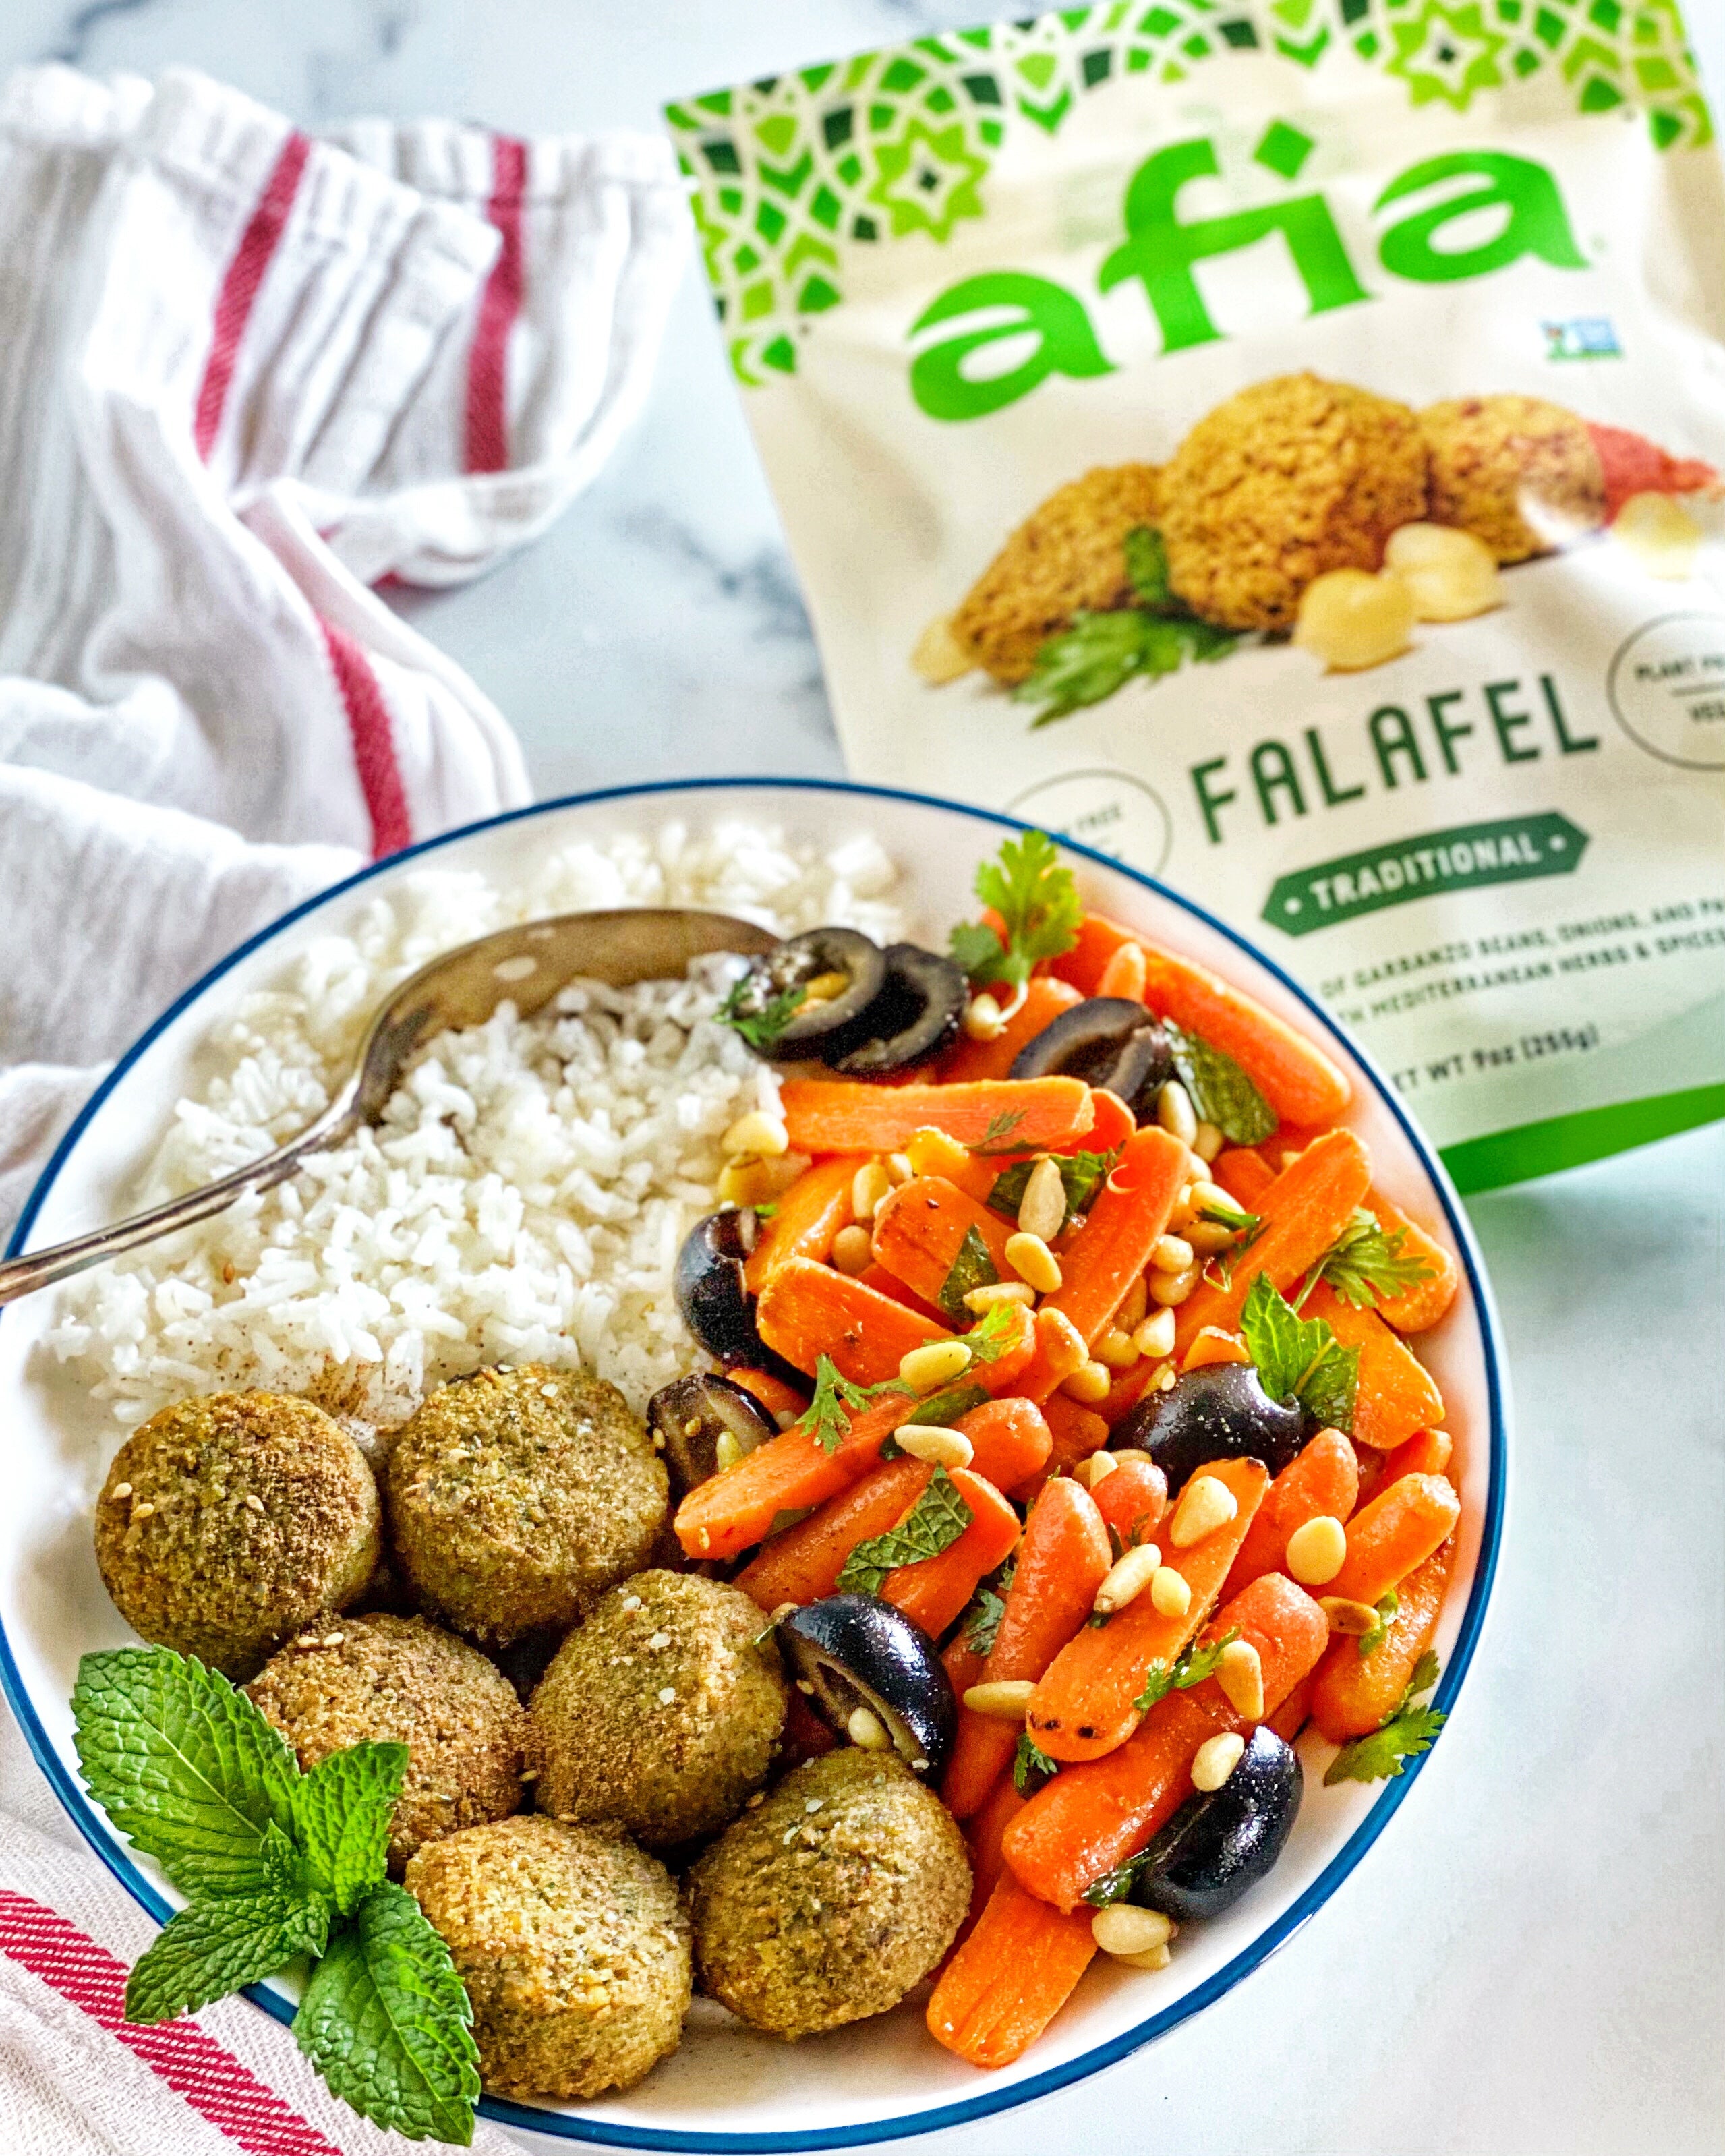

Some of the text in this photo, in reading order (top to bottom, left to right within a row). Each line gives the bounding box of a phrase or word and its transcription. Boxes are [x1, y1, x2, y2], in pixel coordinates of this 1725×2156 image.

[906, 119, 1593, 424] afia
[1190, 675, 1601, 844] FALAFEL
[1309, 832, 1542, 912] TRADITIONAL
[1353, 941, 1473, 988] GARBANZO
[1650, 900, 1695, 925] AND
[1370, 962, 1554, 1018] MEDITERRANEAN
[1556, 943, 1630, 974] HERBS
[1392, 1067, 1419, 1094] ET
[1426, 1052, 1466, 1082] WT
